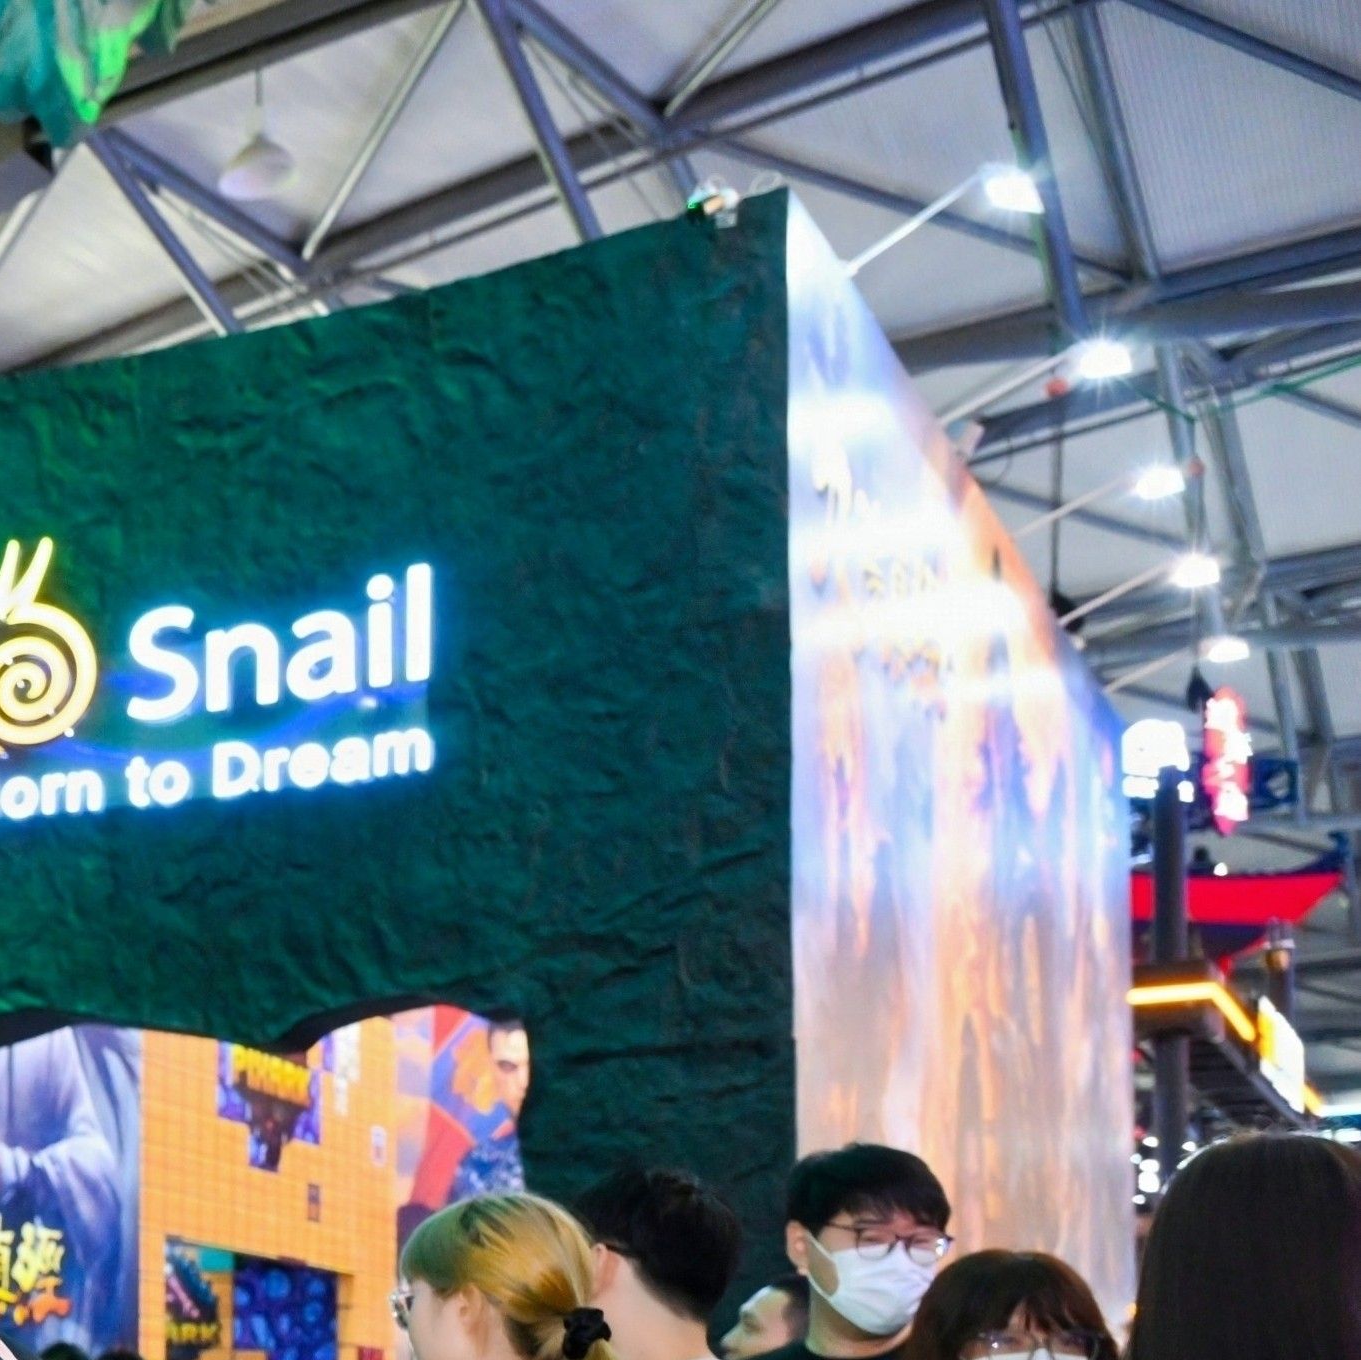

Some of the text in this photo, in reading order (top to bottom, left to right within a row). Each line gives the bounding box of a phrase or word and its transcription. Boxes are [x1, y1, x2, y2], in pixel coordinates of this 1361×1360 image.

[126, 562, 434, 722] Snail
[125, 755, 191, 808] to
[211, 727, 434, 798] Dream
